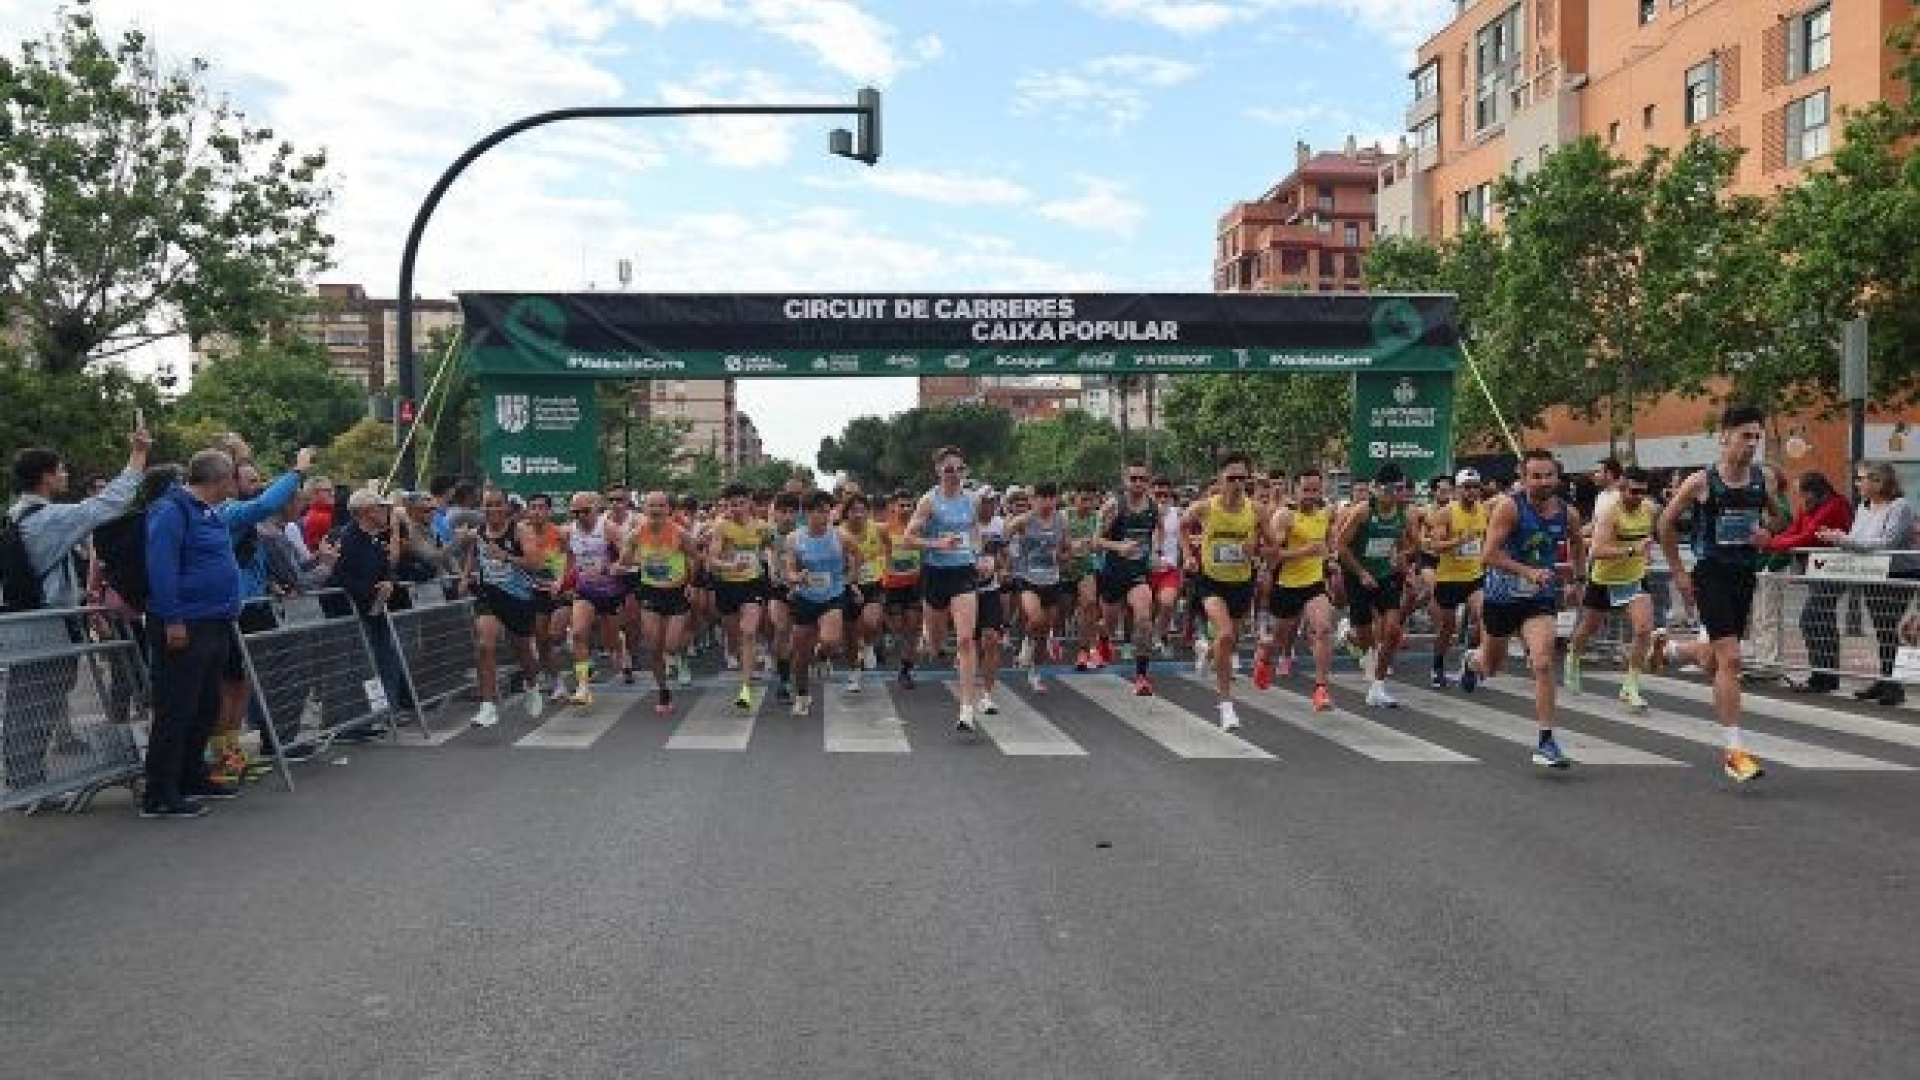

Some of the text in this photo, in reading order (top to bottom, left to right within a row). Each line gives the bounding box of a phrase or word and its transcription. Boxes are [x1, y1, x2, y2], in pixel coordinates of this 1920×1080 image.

[783, 298, 1076, 319] CIRCUIT DE CARRERES
[971, 320, 1056, 341] CAIXA
[1058, 320, 1179, 341] POPULAR
